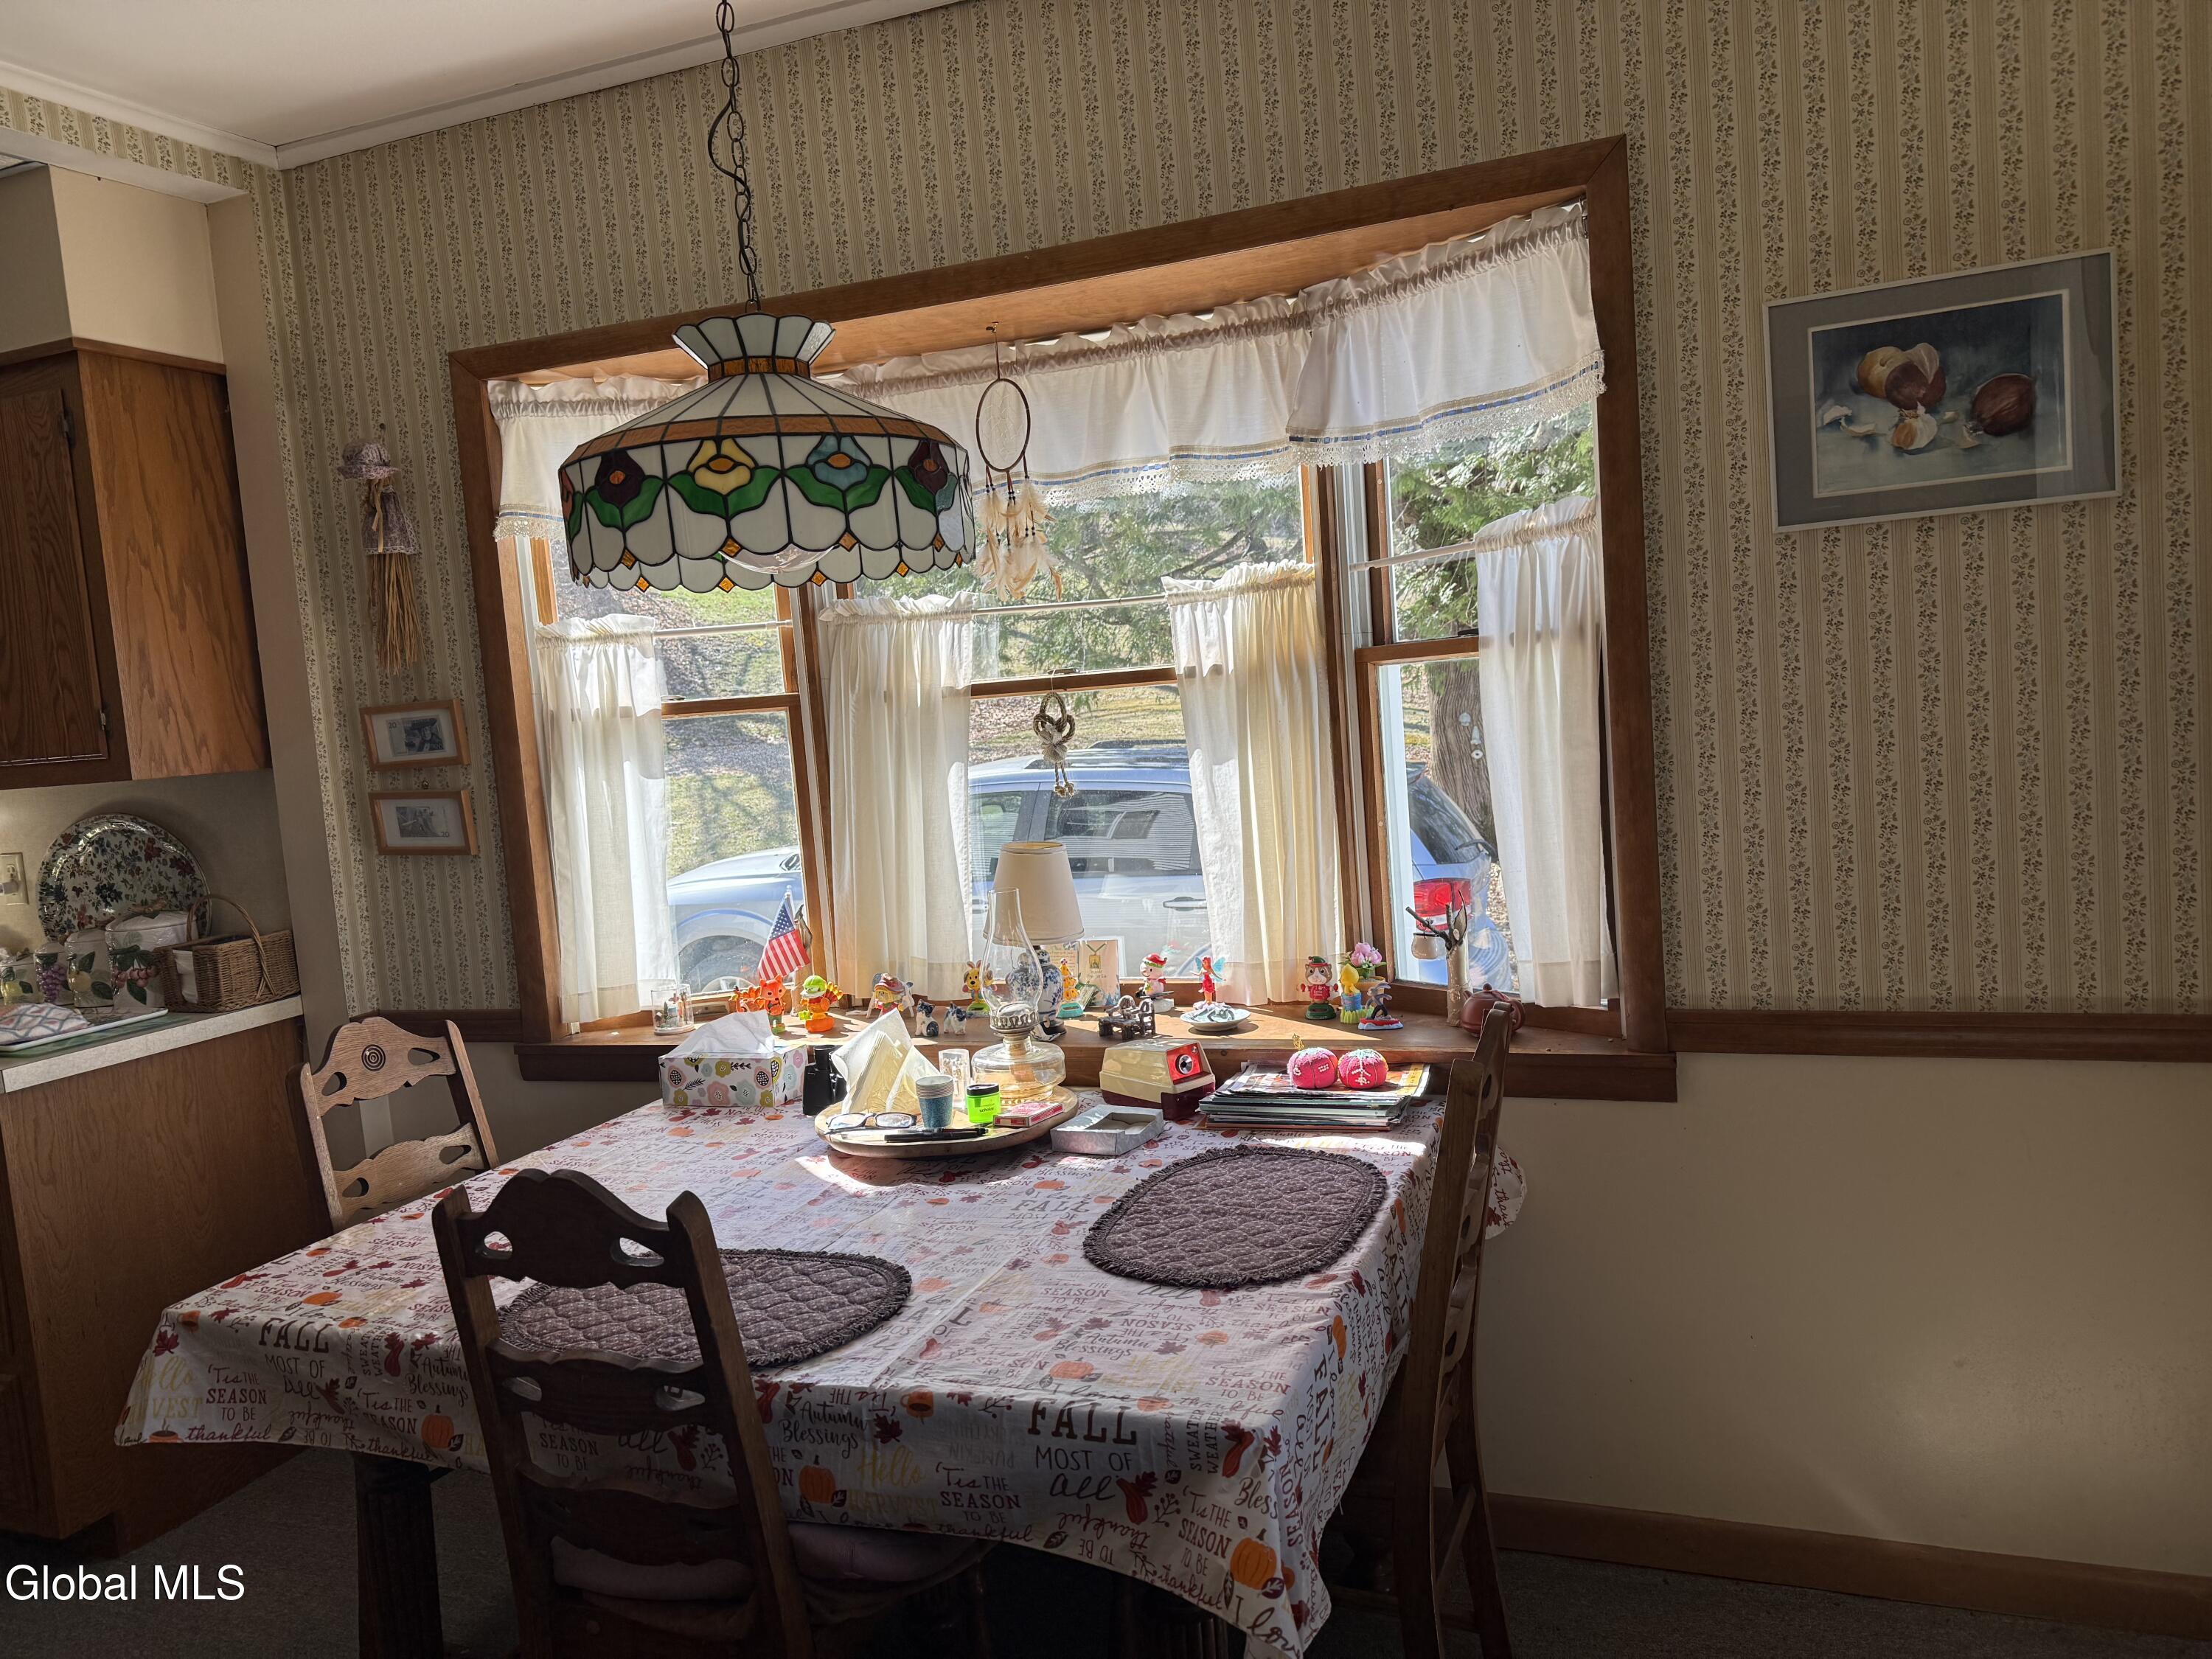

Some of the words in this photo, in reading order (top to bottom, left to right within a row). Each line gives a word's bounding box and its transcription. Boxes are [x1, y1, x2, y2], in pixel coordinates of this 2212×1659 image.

[1352, 1147, 1412, 1157] SEASON
[1032, 1168, 1094, 1179] Blessings
[1009, 1199, 1091, 1213] FALL
[1006, 1212, 1053, 1220] MOST
[1060, 1212, 1079, 1220] OF
[922, 1222, 980, 1231] SEASON
[368, 1238, 422, 1248] SEASON
[1040, 1287, 1110, 1298] SEASON
[1050, 1296, 1066, 1304] TO
[1071, 1296, 1088, 1305] BE
[1137, 1284, 1200, 1300] all
[1254, 1302, 1331, 1317] SEASON
[1121, 1318, 1197, 1332] SEASON
[1121, 1328, 1144, 1338] THE
[259, 1318, 330, 1354] FALL
[1084, 1332, 1151, 1349] Autumn
[1051, 1338, 1133, 1361] Blessings
[264, 1354, 300, 1376] MOST
[309, 1360, 326, 1380] OF
[1261, 1370, 1287, 1381] THE
[242, 1371, 260, 1385] THE
[1205, 1376, 1291, 1395] SEASON
[206, 1388, 268, 1405] SEASON
[406, 1373, 469, 1408] Blessings
[830, 1388, 852, 1405] THE
[1220, 1389, 1239, 1399] TO
[1247, 1391, 1265, 1402] BE
[394, 1397, 413, 1413] THE
[1180, 1397, 1285, 1422] thankful
[1312, 1353, 1329, 1473] FALL
[221, 1406, 235, 1422] TO
[243, 1406, 256, 1422] BE
[799, 1400, 868, 1433] Autumn
[1026, 1399, 1138, 1446] FALL
[185, 1424, 272, 1441] thankful
[304, 1430, 316, 1445] BE
[778, 1419, 859, 1459] Blessings
[540, 1433, 599, 1456] SEASON
[557, 1453, 569, 1469] TO
[857, 1443, 926, 1488] Hello
[1035, 1444, 1093, 1471] MOST
[1107, 1453, 1133, 1472] OF
[981, 1475, 1009, 1491] THE
[1048, 1473, 1116, 1500] all
[939, 1490, 1022, 1510] SEASON
[961, 1510, 981, 1522] TO
[990, 1511, 1006, 1523] BE
[1210, 1503, 1233, 1528] THE
[933, 1523, 1034, 1542] thankful
[1178, 1517, 1234, 1559] SEASON
[1078, 1537, 1093, 1559] BE
[1099, 1544, 1115, 1566] TO
[1180, 1547, 1193, 1568] TO
[1196, 1553, 1209, 1577] BE
[1158, 1564, 1223, 1610] thankful
